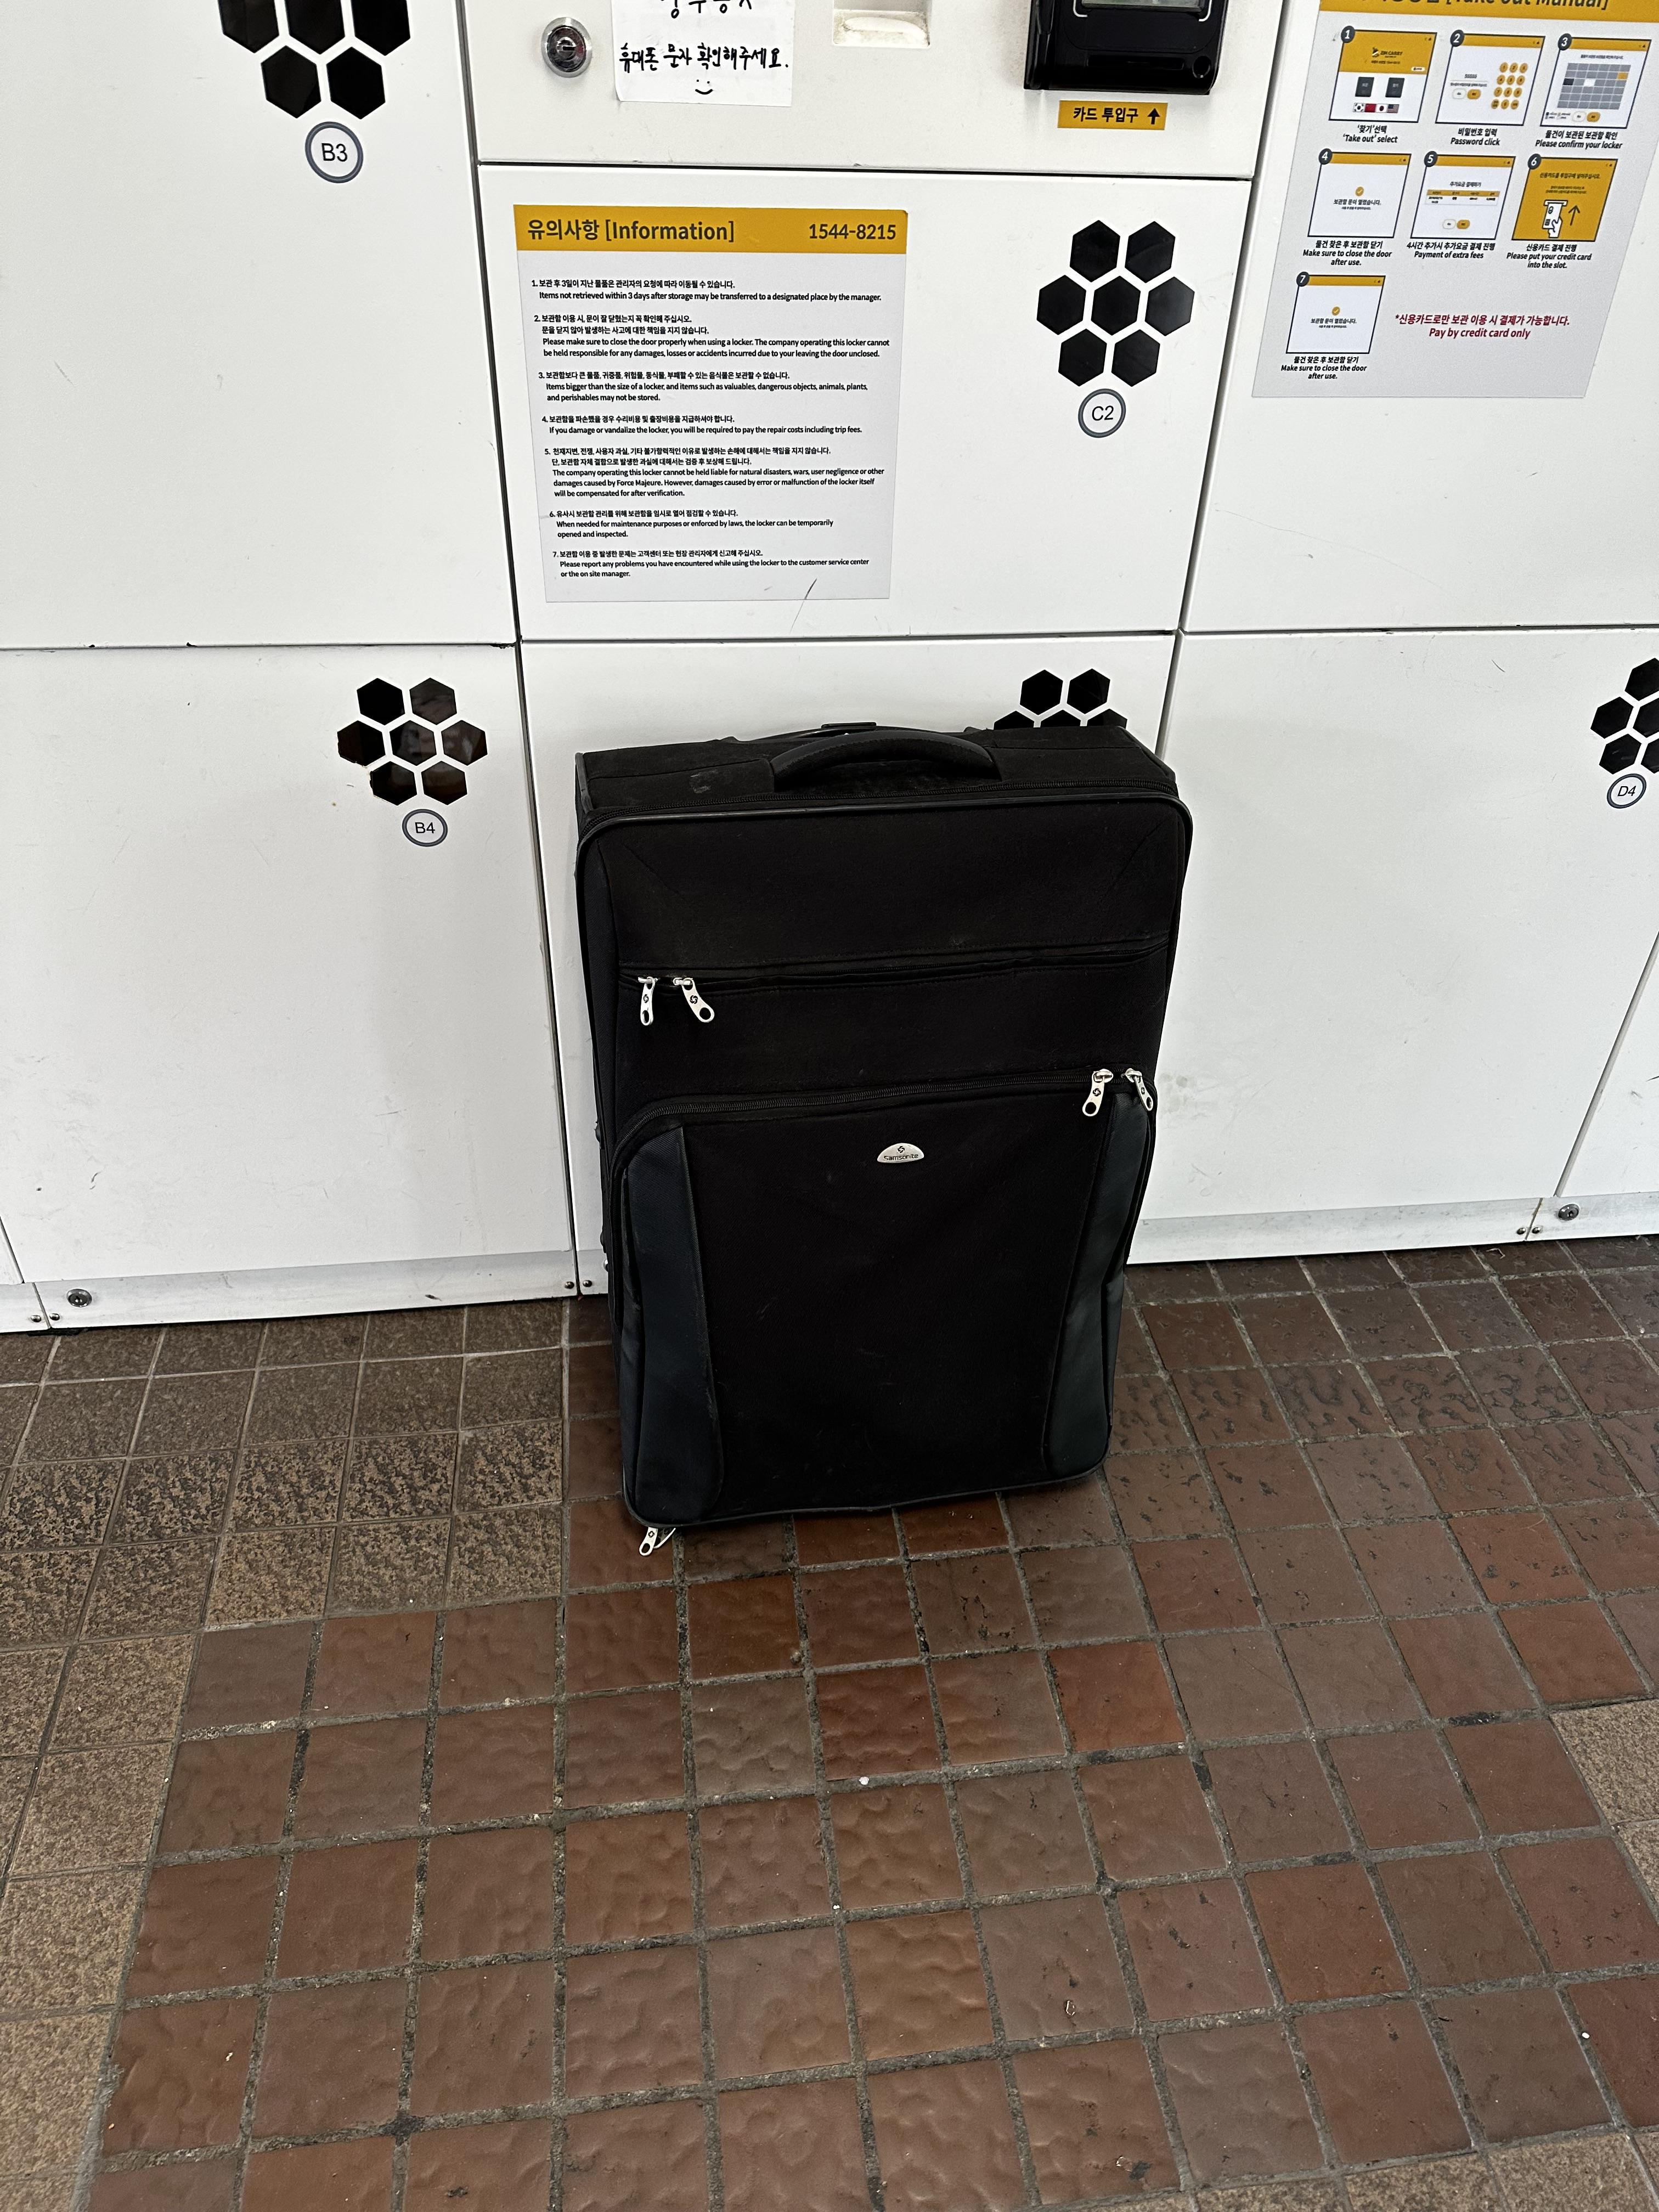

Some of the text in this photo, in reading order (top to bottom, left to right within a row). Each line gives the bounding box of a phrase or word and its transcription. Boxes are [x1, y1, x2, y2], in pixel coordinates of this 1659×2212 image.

[1345, 30, 1350, 39] 1
[1453, 33, 1460, 42] 2
[1561, 37, 1568, 46] 3
[619, 42, 789, 73] 휴대폰 문자 확인해주세요.
[1073, 106, 1138, 123] 카드 투입구
[1458, 127, 1497, 137] 비밀번호 입력
[1545, 129, 1618, 140] 물건이 보관된 보관함 확인
[1377, 134, 1398, 143] select
[1535, 139, 1557, 147] Please
[1601, 140, 1623, 149] locker
[321, 143, 347, 162] B3
[1322, 151, 1328, 160] 4
[1427, 155, 1434, 163] 5
[1531, 157, 1537, 166] 6
[528, 219, 733, 242] 유의사항 [Information]
[810, 223, 895, 240] 1544-8215
[1316, 240, 1383, 249] 물건 찾은 후 보관함 닫기
[1407, 241, 1423, 249] 4시간
[1424, 241, 1443, 250] 추가시
[1444, 241, 1468, 250] 추가요금
[1470, 242, 1482, 250] 결제
[1527, 243, 1550, 251] 신용카드
[1414, 251, 1443, 259] Payment
[539, 279, 552, 287] 보관
[553, 279, 561, 287] 후
[562, 279, 579, 287] 3일이
[580, 279, 594, 287] 지난
[595, 279, 614, 287] 물품은
[616, 279, 642, 288] 관리자의
[644, 279, 663, 288] 요청에
[664, 280, 677, 288] 따라
[679, 280, 698, 288] 이동될
[699, 280, 706, 289] 수
[707, 280, 735, 289] 있습니다.
[634, 291, 650, 301] days
[668, 292, 693, 301] storage
[772, 292, 809, 302] designated
[811, 292, 828, 302] place
[830, 293, 837, 302] by
[563, 314, 575, 323] 이용
[577, 314, 585, 323] 시,
[586, 314, 599, 323] 문이
[600, 314, 607, 323] 잘
[608, 314, 634, 323] 닫혔는지
[644, 314, 663, 323] 확인해
[664, 314, 692, 323] 주십시오.
[1451, 314, 1469, 325] 보관
[1471, 314, 1487, 325] 이용
[1489, 314, 1498, 325] 시
[1500, 314, 1525, 325] 결제가
[1429, 327, 1531, 340] Pay by credit card only
[561, 393, 599, 402] perishables
[1092, 405, 1114, 421] C2
[576, 489, 619, 498] compensated
[557, 531, 581, 539] opened
[1617, 786, 1636, 796] D4
[415, 822, 435, 834] B4
